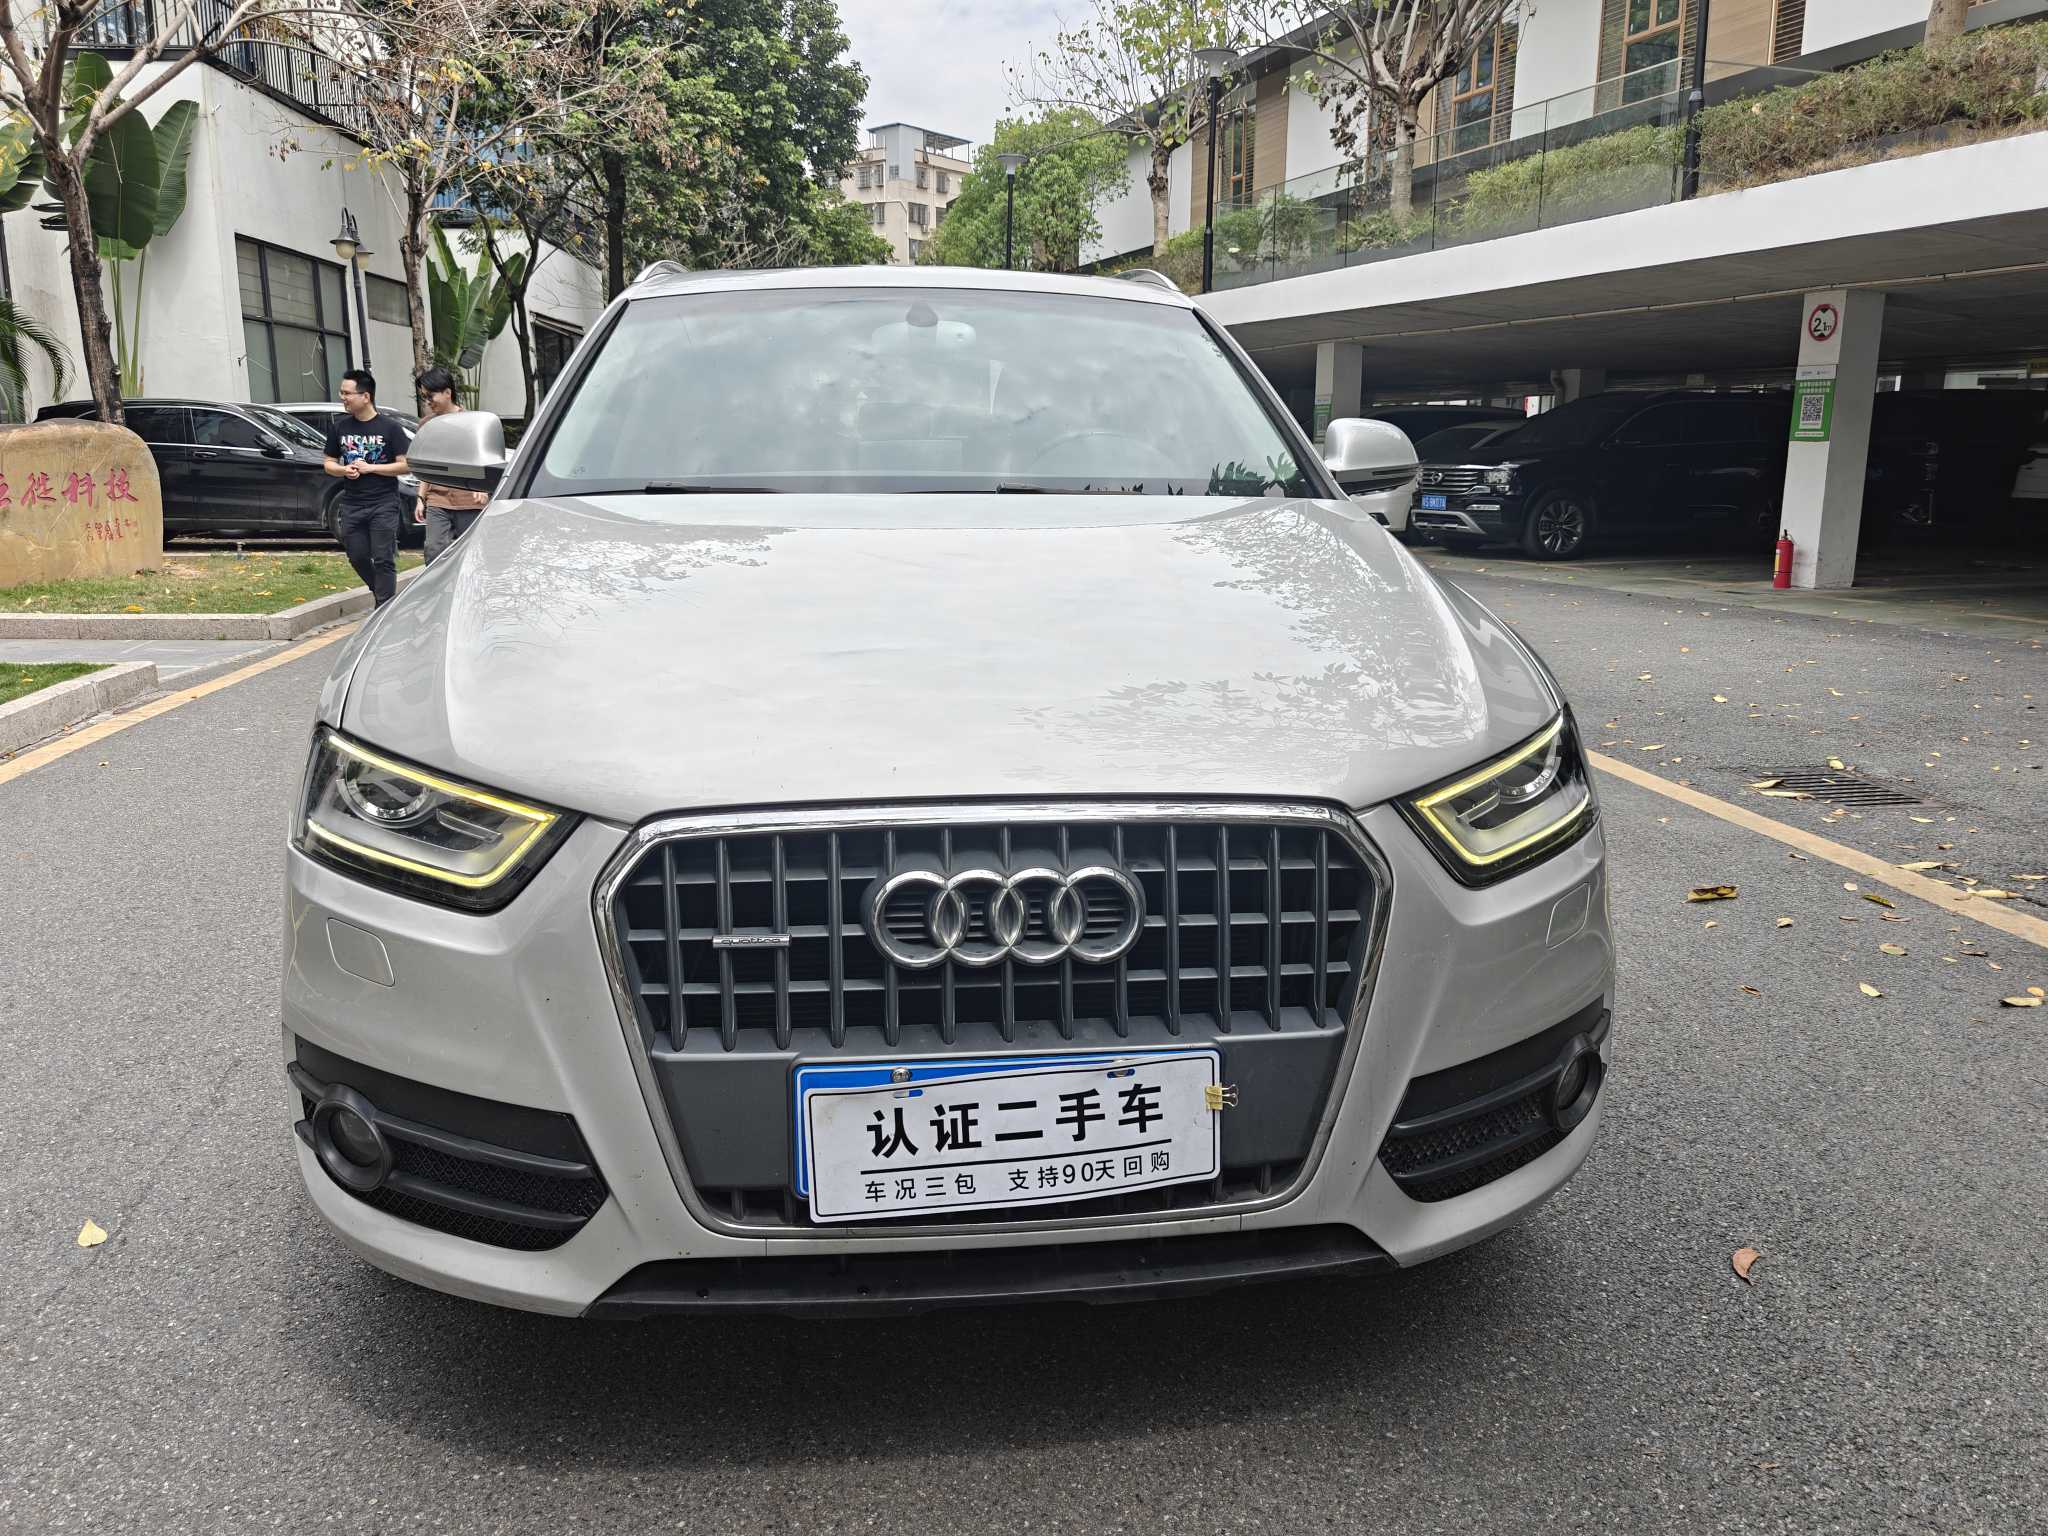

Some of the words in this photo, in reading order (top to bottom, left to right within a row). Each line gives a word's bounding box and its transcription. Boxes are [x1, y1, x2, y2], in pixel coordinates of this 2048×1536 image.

[340, 434, 385, 445] ARCANE
[720, 936, 781, 946] quattro
[866, 1083, 1163, 1158] 认证二手车
[865, 1172, 976, 1202] 车况三包
[1008, 1151, 1169, 1192] 支持90天回购
